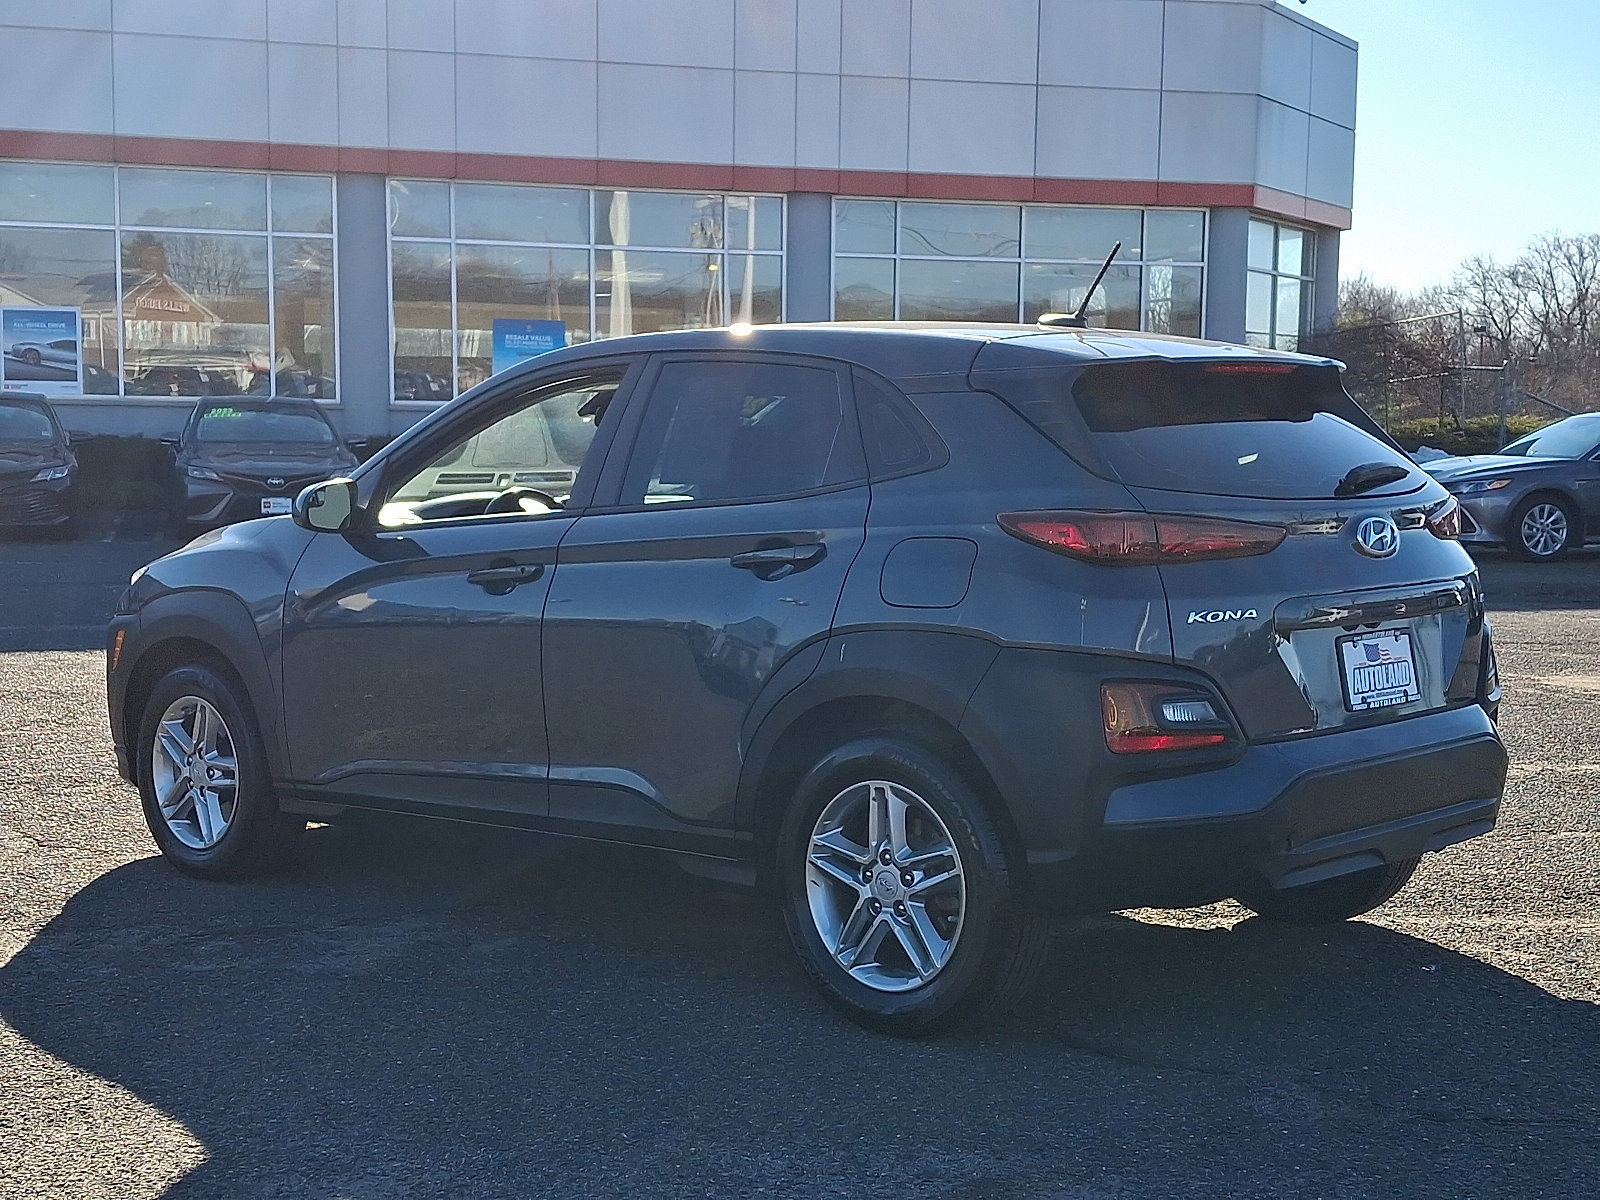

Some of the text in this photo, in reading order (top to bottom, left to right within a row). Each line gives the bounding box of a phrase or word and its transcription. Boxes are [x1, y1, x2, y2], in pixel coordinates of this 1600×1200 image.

[1187, 609, 1258, 624] KONA
[1353, 661, 1410, 694] AUTOLAND
[1369, 696, 1406, 708] AUTOLAND
